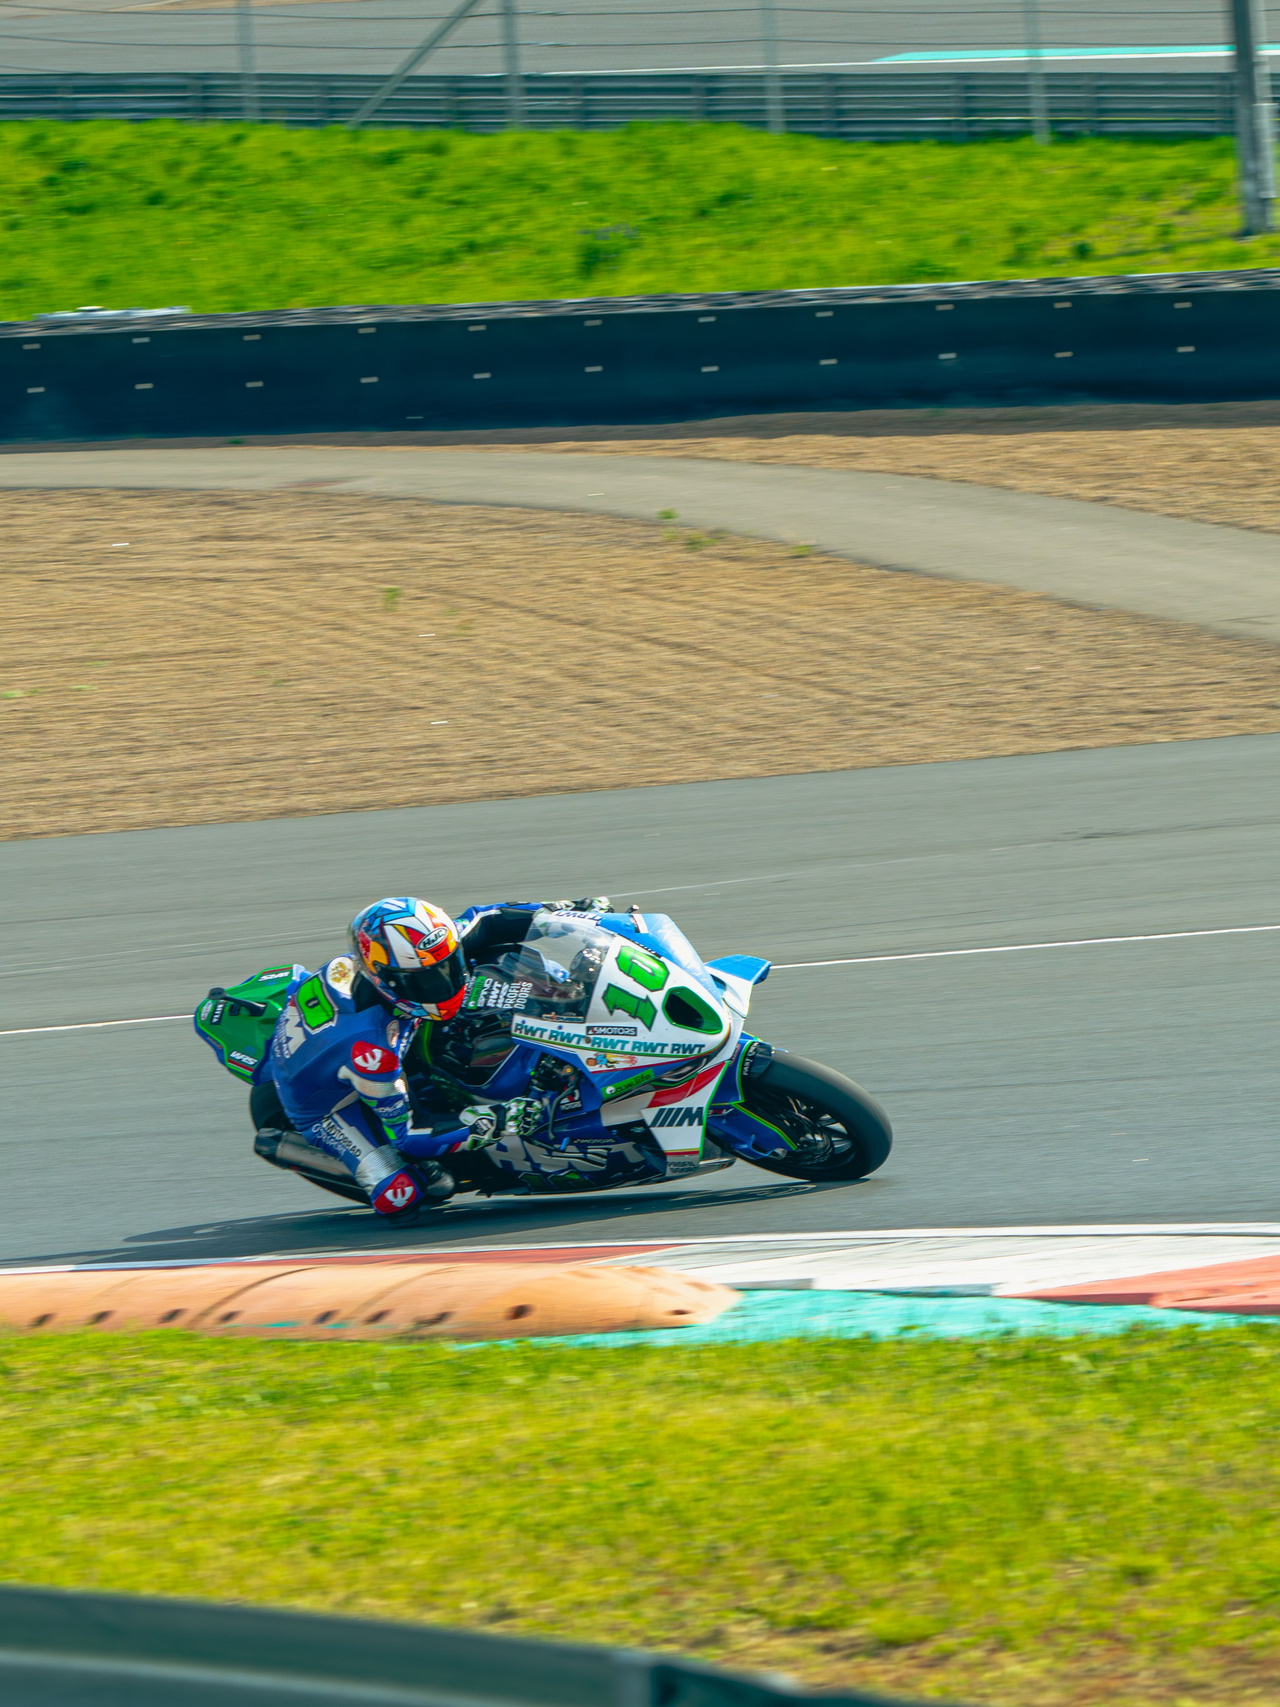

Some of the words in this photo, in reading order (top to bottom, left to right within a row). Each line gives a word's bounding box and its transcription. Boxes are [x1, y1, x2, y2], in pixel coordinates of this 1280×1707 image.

[423, 929, 445, 950] HJC
[485, 980, 502, 1007] RWT
[502, 980, 522, 1008] PROFIL
[513, 980, 533, 1009] DOORS
[602, 945, 670, 1031] 10
[514, 1023, 548, 1039] RWT
[548, 1030, 587, 1045] RWT
[590, 1036, 631, 1051] RWT
[632, 1041, 669, 1054] RWT
[670, 1043, 706, 1055] RWT
[229, 1051, 258, 1067] WRS
